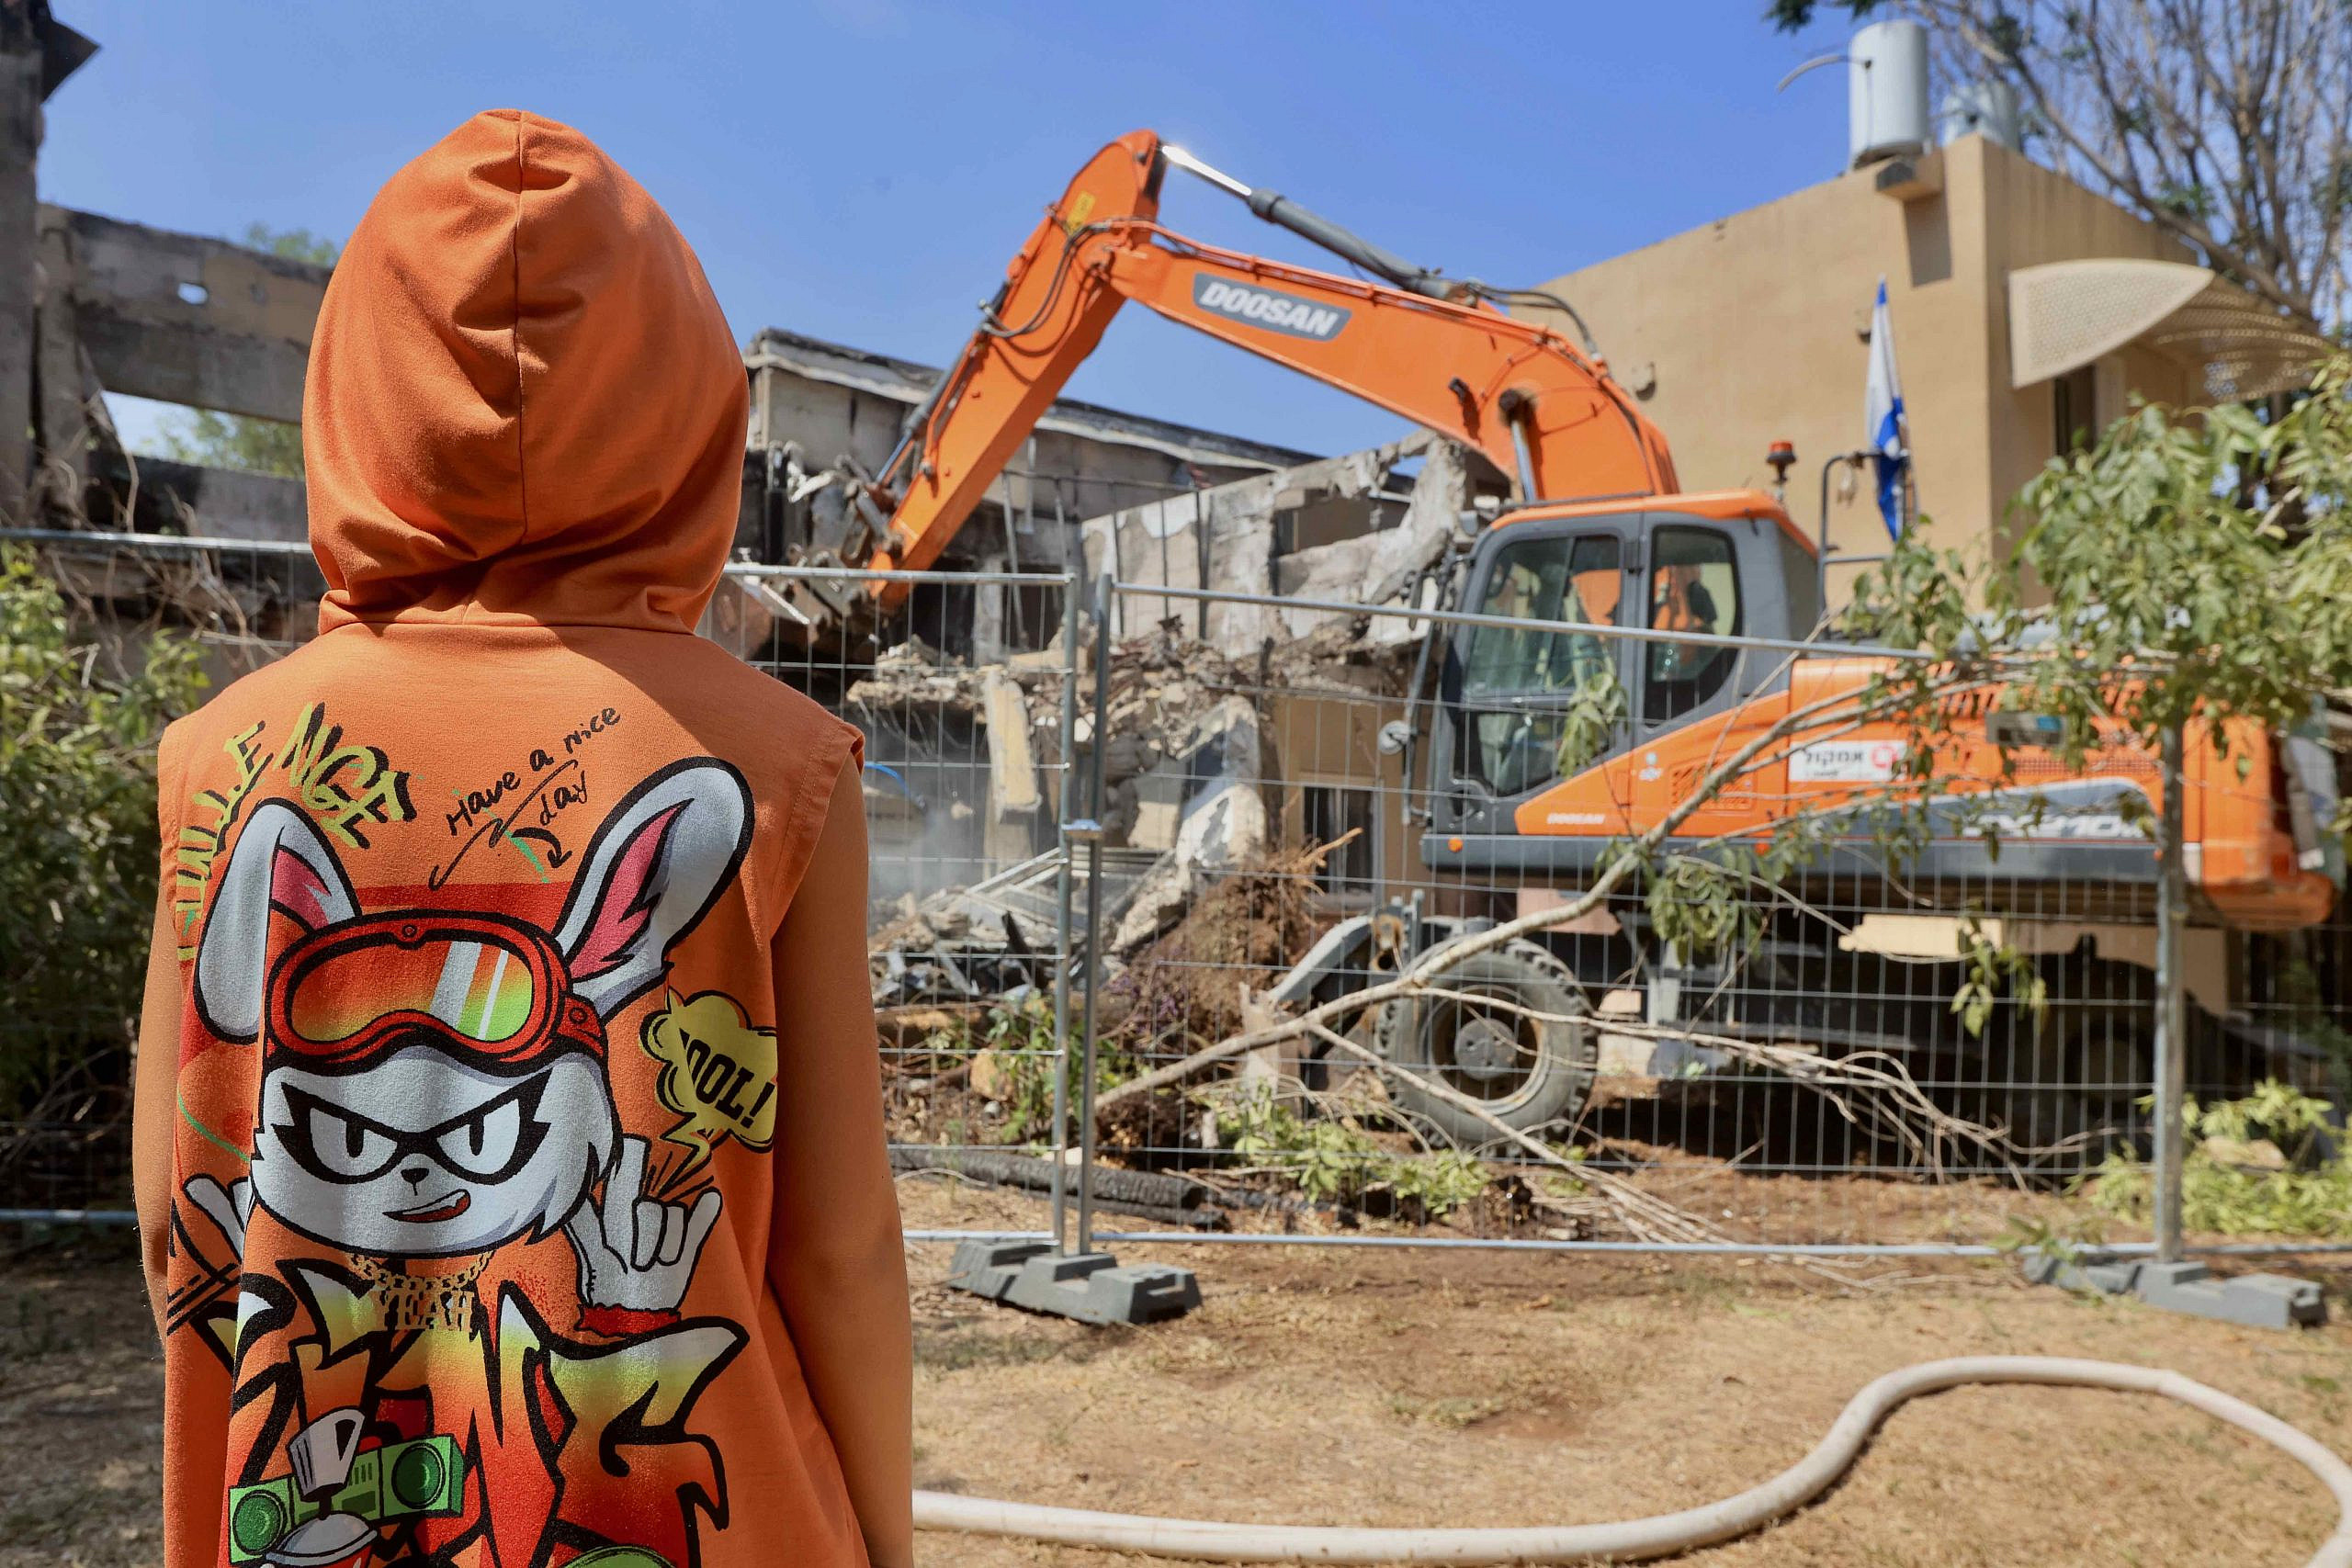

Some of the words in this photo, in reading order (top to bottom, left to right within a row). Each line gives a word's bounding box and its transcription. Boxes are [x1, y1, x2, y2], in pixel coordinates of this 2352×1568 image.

[1199, 281, 1339, 336] DOOSAN
[446, 771, 521, 836] Have
[529, 749, 554, 772] a
[563, 707, 621, 754] nice
[540, 770, 588, 826] day
[679, 1028, 775, 1130] OOL!
[370, 1288, 475, 1332] YEAH
